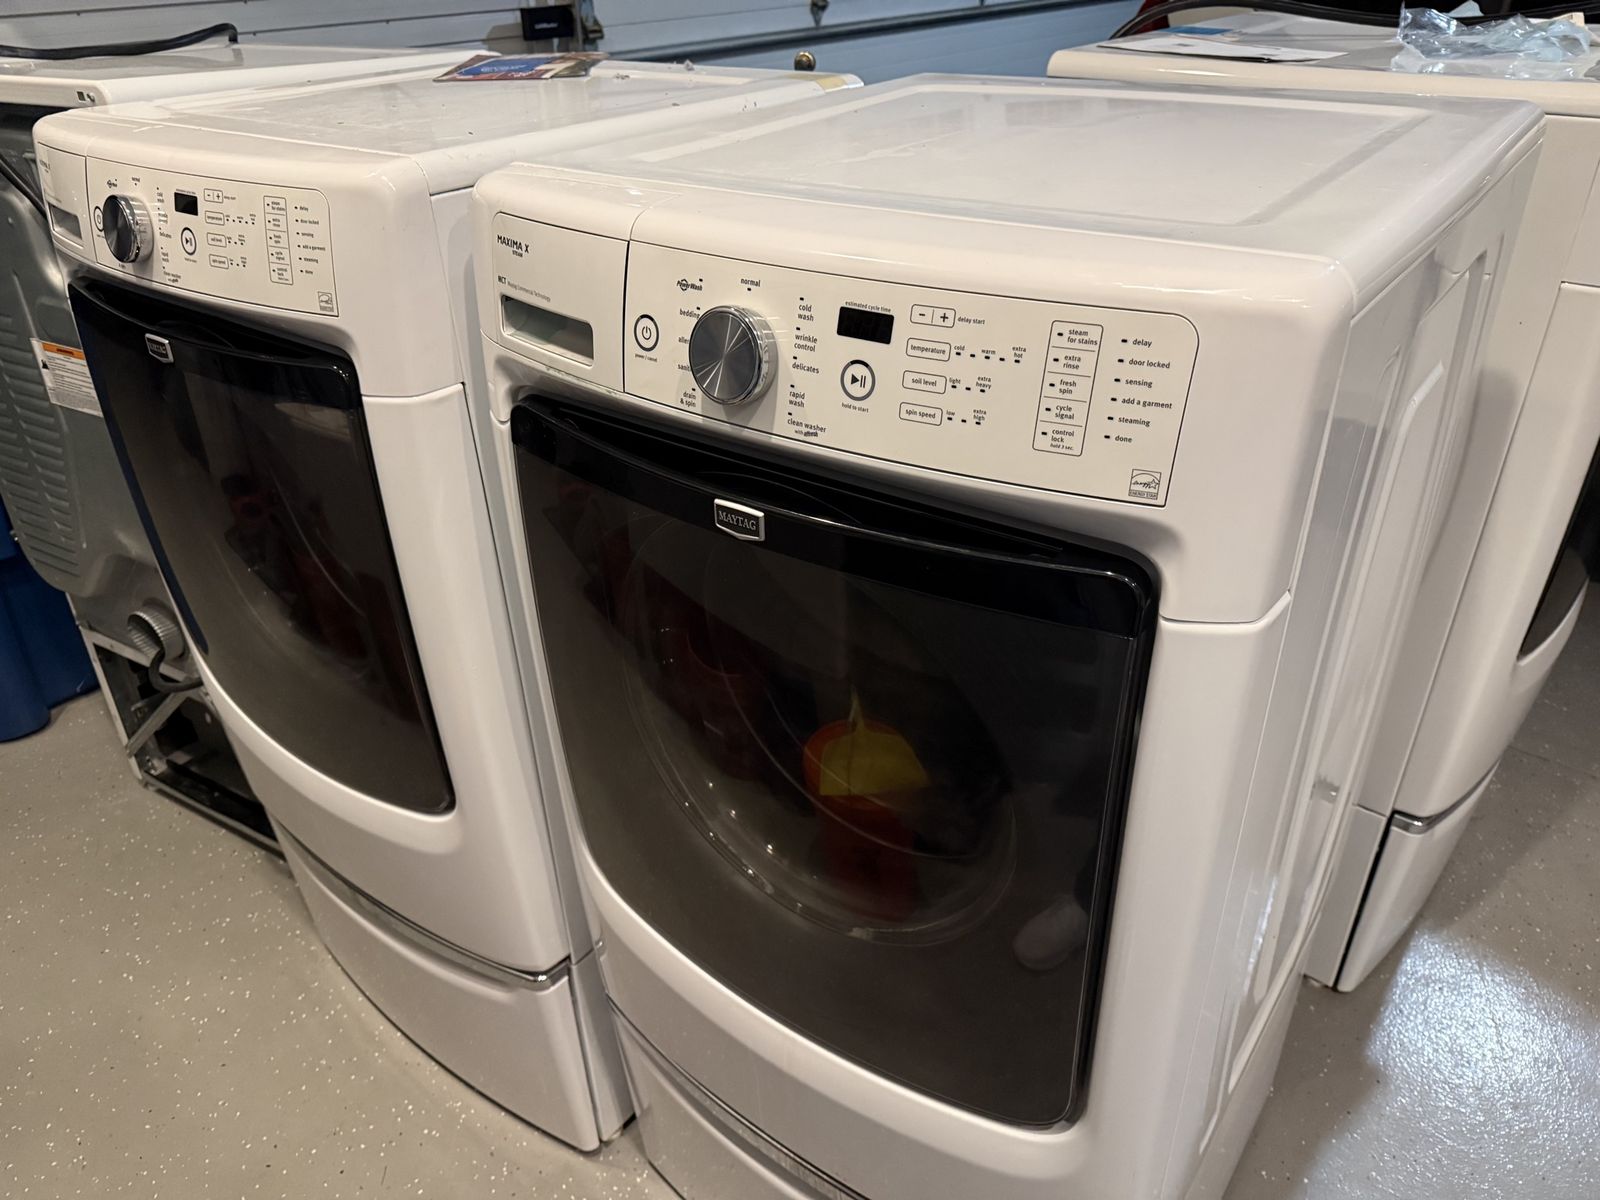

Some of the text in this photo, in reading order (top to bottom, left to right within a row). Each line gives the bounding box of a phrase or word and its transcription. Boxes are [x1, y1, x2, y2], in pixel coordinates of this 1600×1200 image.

[497, 234, 529, 253] MAXIMA X
[740, 278, 760, 287] normal
[798, 304, 812, 312] cold
[845, 301, 867, 309] estimated
[868, 304, 880, 312] cycle
[798, 313, 814, 321] wash
[958, 316, 972, 324] delay
[795, 333, 818, 344] wrinkle
[1067, 336, 1098, 346] for stains
[1132, 338, 1152, 348] delay
[794, 342, 816, 352] control
[910, 345, 946, 355] temperature
[792, 362, 819, 374] delicates
[1063, 362, 1079, 370] rinse
[1146, 360, 1170, 369] locked
[923, 379, 937, 387] level
[976, 381, 991, 389] heavy
[1060, 379, 1076, 387] fresh
[1125, 378, 1152, 388] sensing
[683, 391, 696, 400] drain
[790, 390, 805, 400] rapid
[1059, 387, 1072, 395] spin
[685, 399, 696, 408] spin
[789, 399, 804, 408] wash
[1121, 397, 1135, 405] add
[1142, 400, 1172, 409] garment
[1056, 404, 1072, 413] cycle
[905, 408, 936, 419] spin speed
[1055, 412, 1074, 420] signal
[787, 418, 826, 433] clean washer
[1118, 416, 1150, 427] steaming
[1052, 428, 1074, 437] control
[1115, 435, 1132, 443] done
[719, 511, 756, 530] MAYTAG
